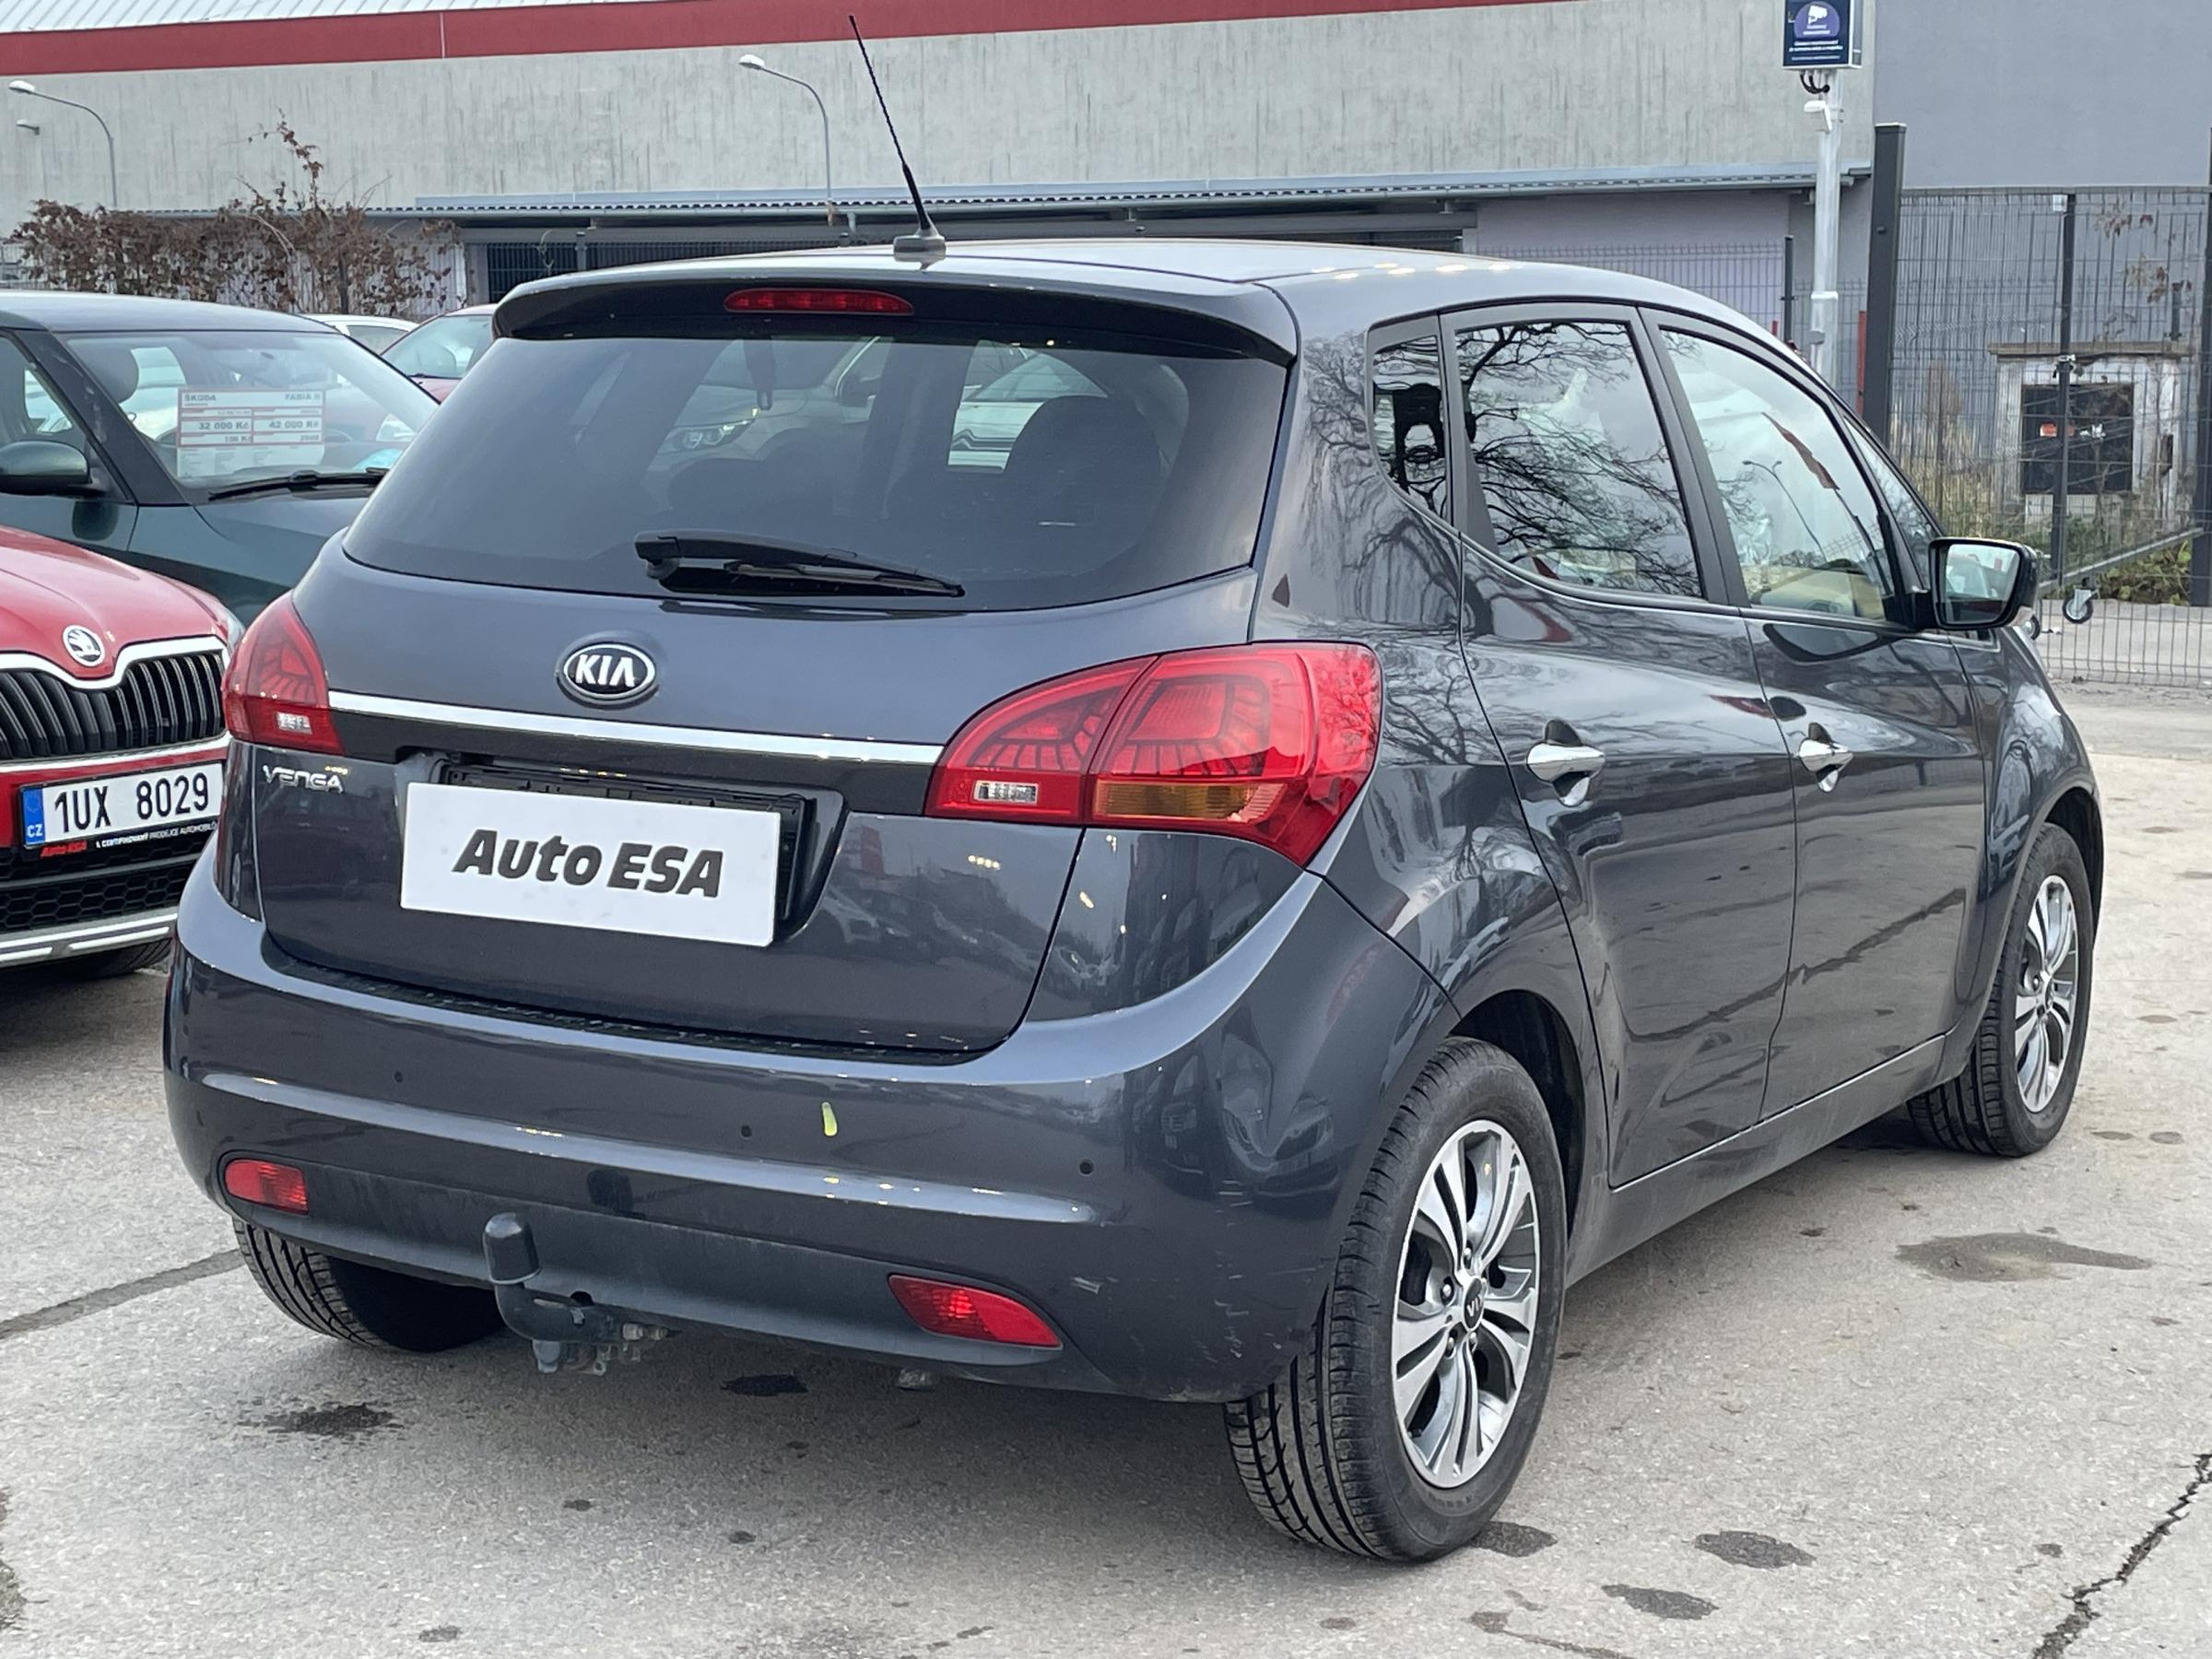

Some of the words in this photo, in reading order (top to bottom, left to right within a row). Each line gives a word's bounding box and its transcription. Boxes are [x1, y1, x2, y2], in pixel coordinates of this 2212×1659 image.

[285, 420, 303, 429] 000
[575, 653, 635, 688] KIA
[262, 764, 345, 794] VENGA
[54, 785, 111, 833] 1UX
[136, 772, 209, 819] 8029
[27, 823, 43, 838] CZ
[452, 829, 603, 886] Auto
[607, 842, 724, 898] ESA
